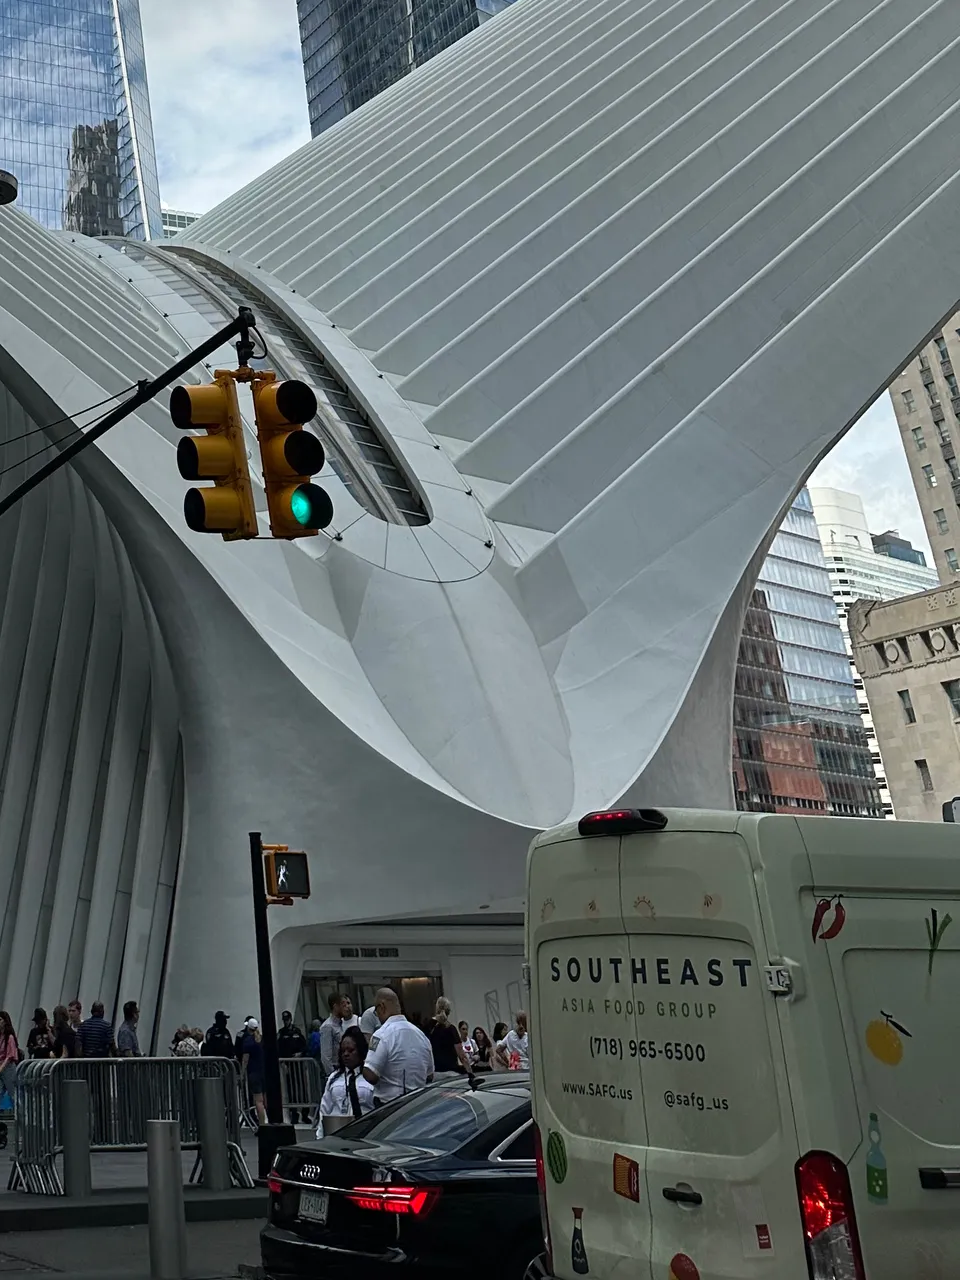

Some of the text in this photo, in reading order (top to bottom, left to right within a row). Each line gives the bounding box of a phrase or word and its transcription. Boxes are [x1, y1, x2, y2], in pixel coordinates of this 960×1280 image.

[551, 957, 752, 987] SOUTHEAST
[562, 998, 716, 1018] ASIA FOOD GROUP
[590, 1036, 705, 1062] (718) 965-6500
[562, 1083, 632, 1100] www.SAFG.us
[664, 1090, 729, 1111] @safg_us
